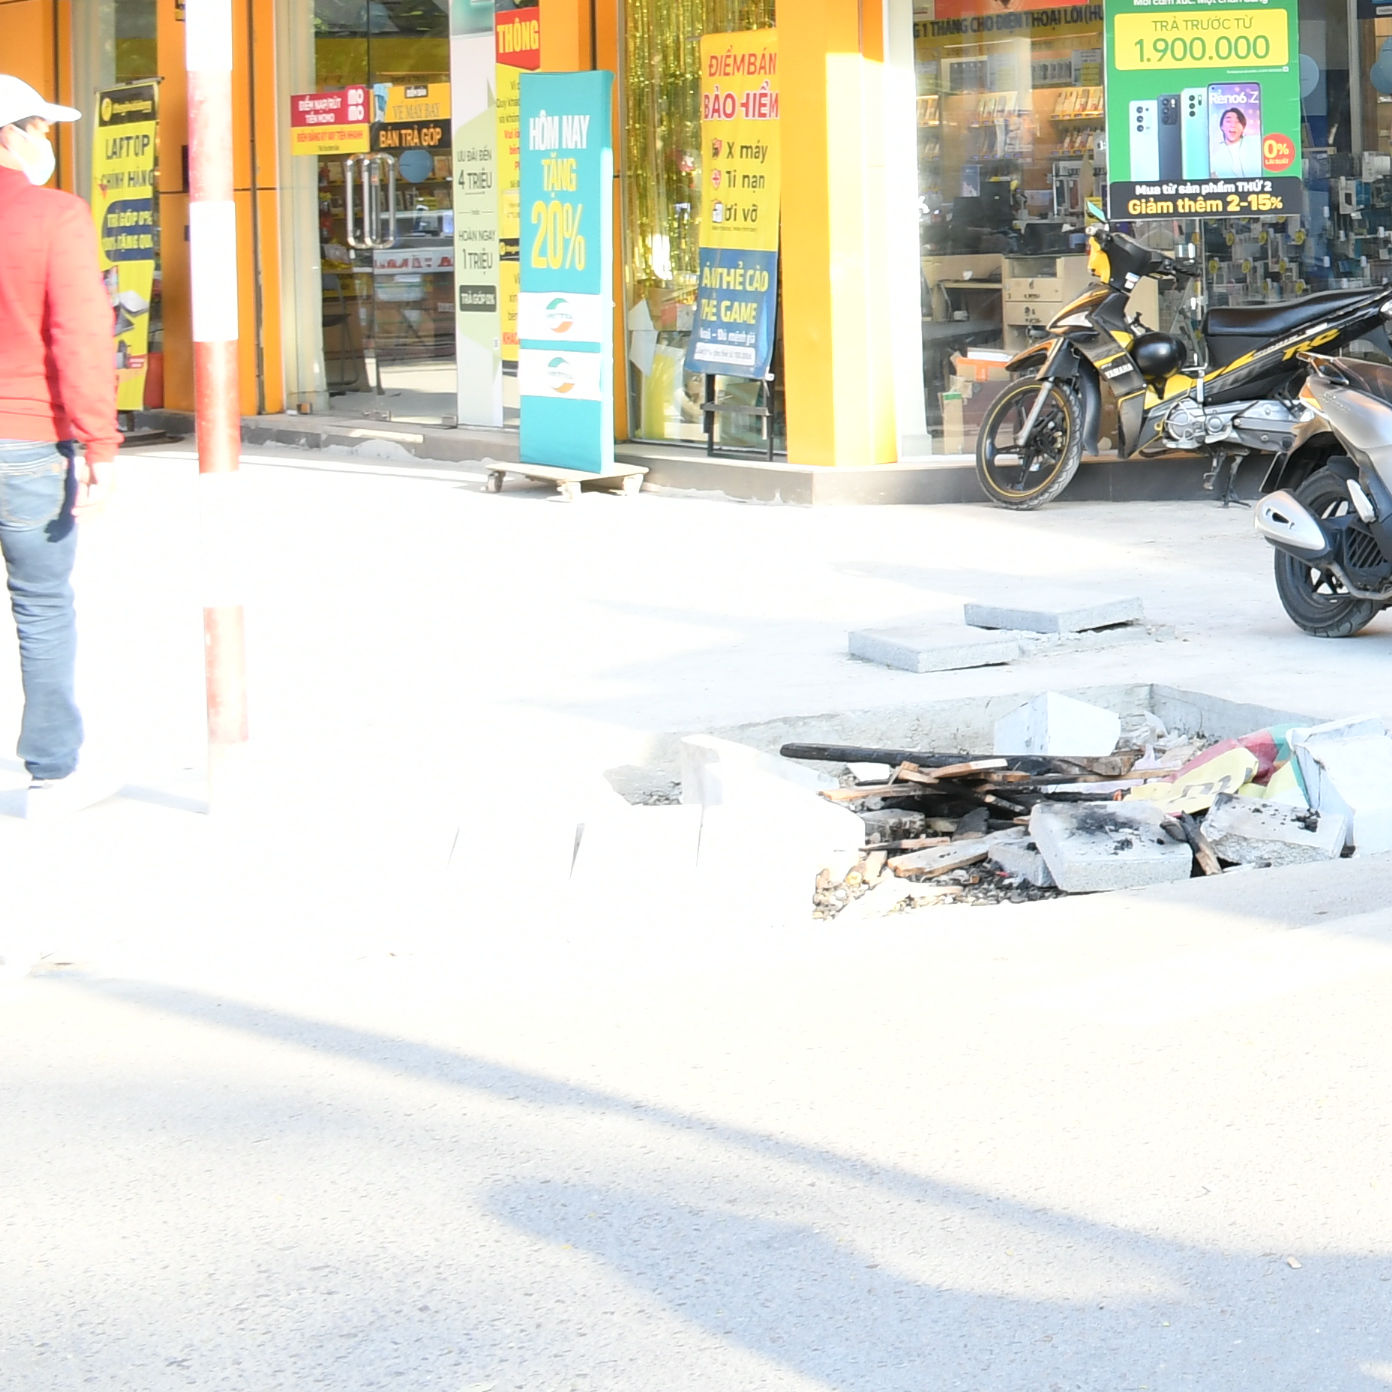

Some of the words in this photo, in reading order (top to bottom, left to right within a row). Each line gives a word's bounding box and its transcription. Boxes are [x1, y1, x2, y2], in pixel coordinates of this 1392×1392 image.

[496, 17, 539, 54] THÔNG
[1152, 15, 1179, 33] TRẢ
[1183, 15, 1231, 31] TRƯỚC
[1234, 14, 1255, 30] TỪ
[708, 44, 746, 78] ĐIỂM
[746, 47, 778, 76] BÁN
[1134, 34, 1271, 63] 1.900.000
[703, 84, 737, 121] BẢO
[1208, 91, 1248, 105] Reno6
[1249, 91, 1260, 105] Z
[379, 125, 400, 148] BÁN
[401, 124, 419, 147] TRẢ
[420, 123, 442, 146] GÓP
[529, 109, 559, 150] HÔM
[562, 115, 590, 150] NAY
[105, 134, 151, 161] LAPTOP
[739, 139, 768, 165] máy
[1263, 139, 1290, 159] 0%
[458, 169, 465, 190] 4
[467, 167, 493, 195] TRIỆU
[541, 151, 577, 198] TẶNG
[742, 173, 765, 194] nạn
[1135, 184, 1161, 196] Mua
[1179, 181, 1201, 194] sản
[1201, 181, 1236, 196] phẩm
[1237, 179, 1265, 193] THỨ
[1265, 181, 1273, 192] 2
[724, 203, 738, 222] ơi
[742, 202, 759, 223] vỡ
[1128, 196, 1174, 215] Giảm
[1177, 194, 1223, 213] thêm
[1226, 193, 1283, 212] 2-15%
[458, 226, 477, 242] HOÀN
[478, 229, 496, 242] NGAY
[530, 200, 587, 271] 20%
[462, 248, 467, 270] 1
[468, 247, 493, 275] TRIỆU
[720, 299, 758, 325] GAME
[1104, 363, 1134, 380] YAMAHA
